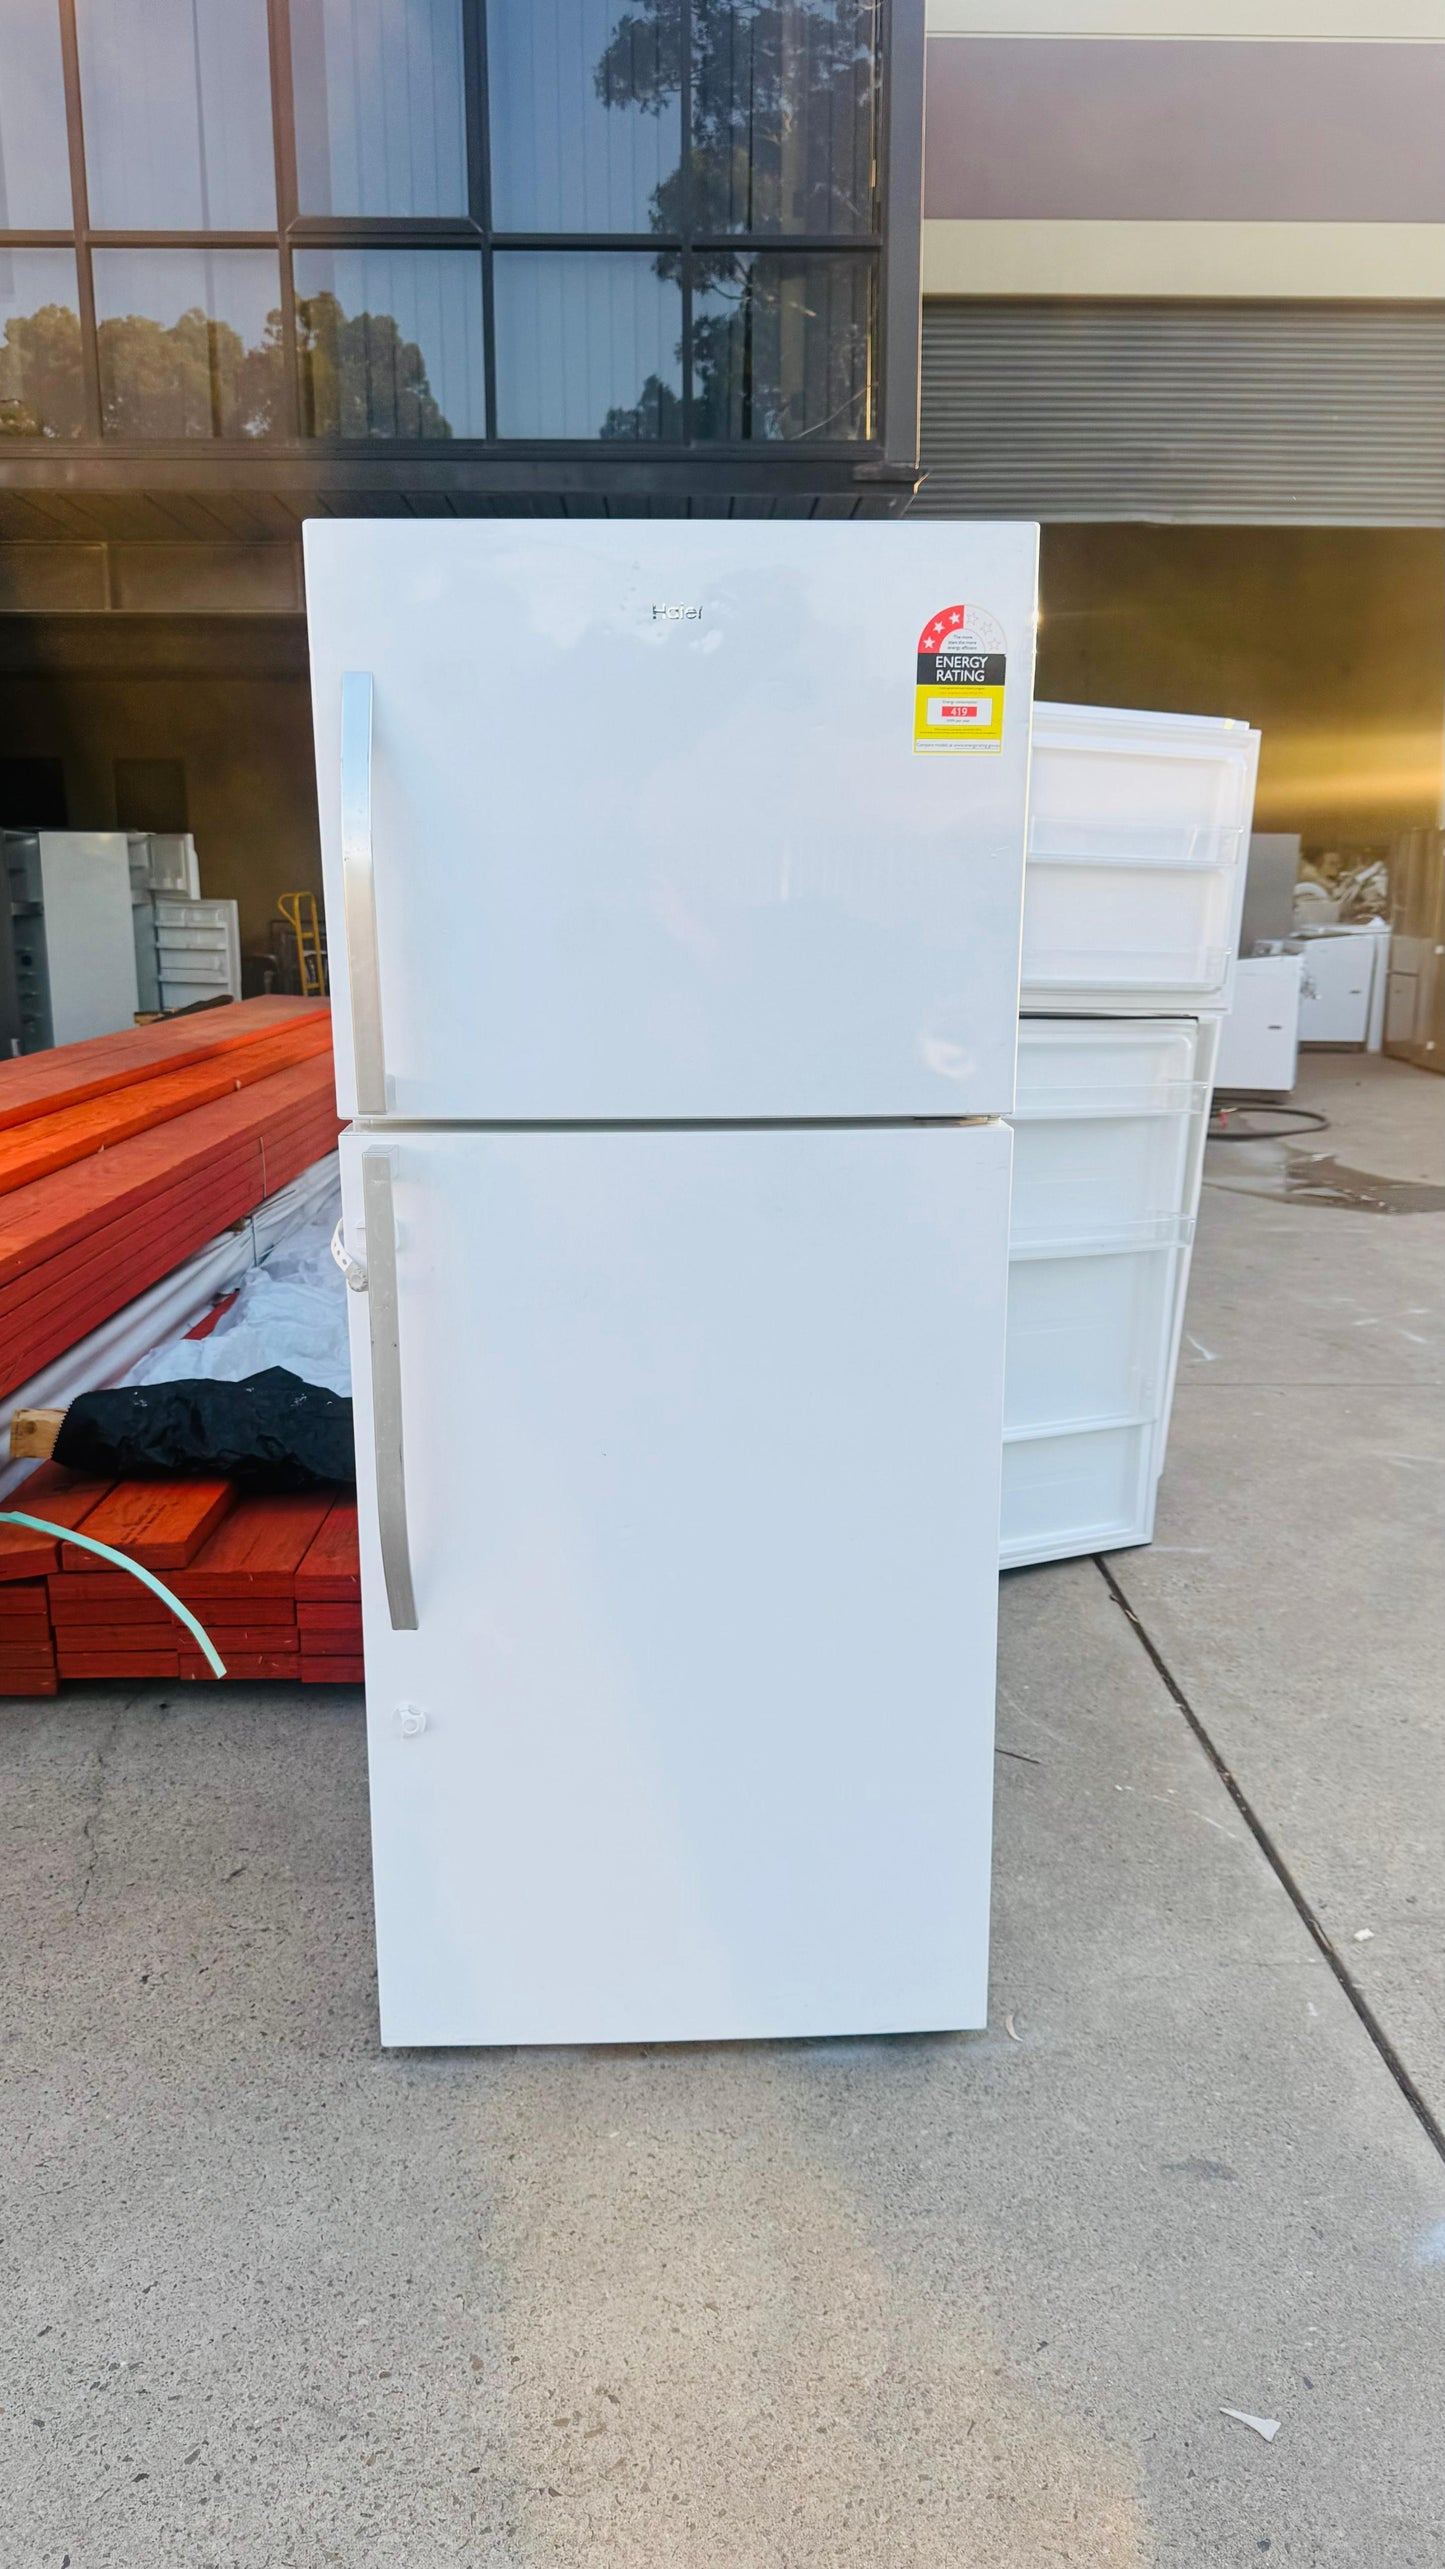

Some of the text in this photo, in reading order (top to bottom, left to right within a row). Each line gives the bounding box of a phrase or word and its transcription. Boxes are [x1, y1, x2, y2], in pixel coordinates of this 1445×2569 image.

[652, 602, 703, 620] Haier
[935, 655, 988, 669] ENERGY
[936, 669, 985, 682] RATING
[950, 707, 968, 716] 419
